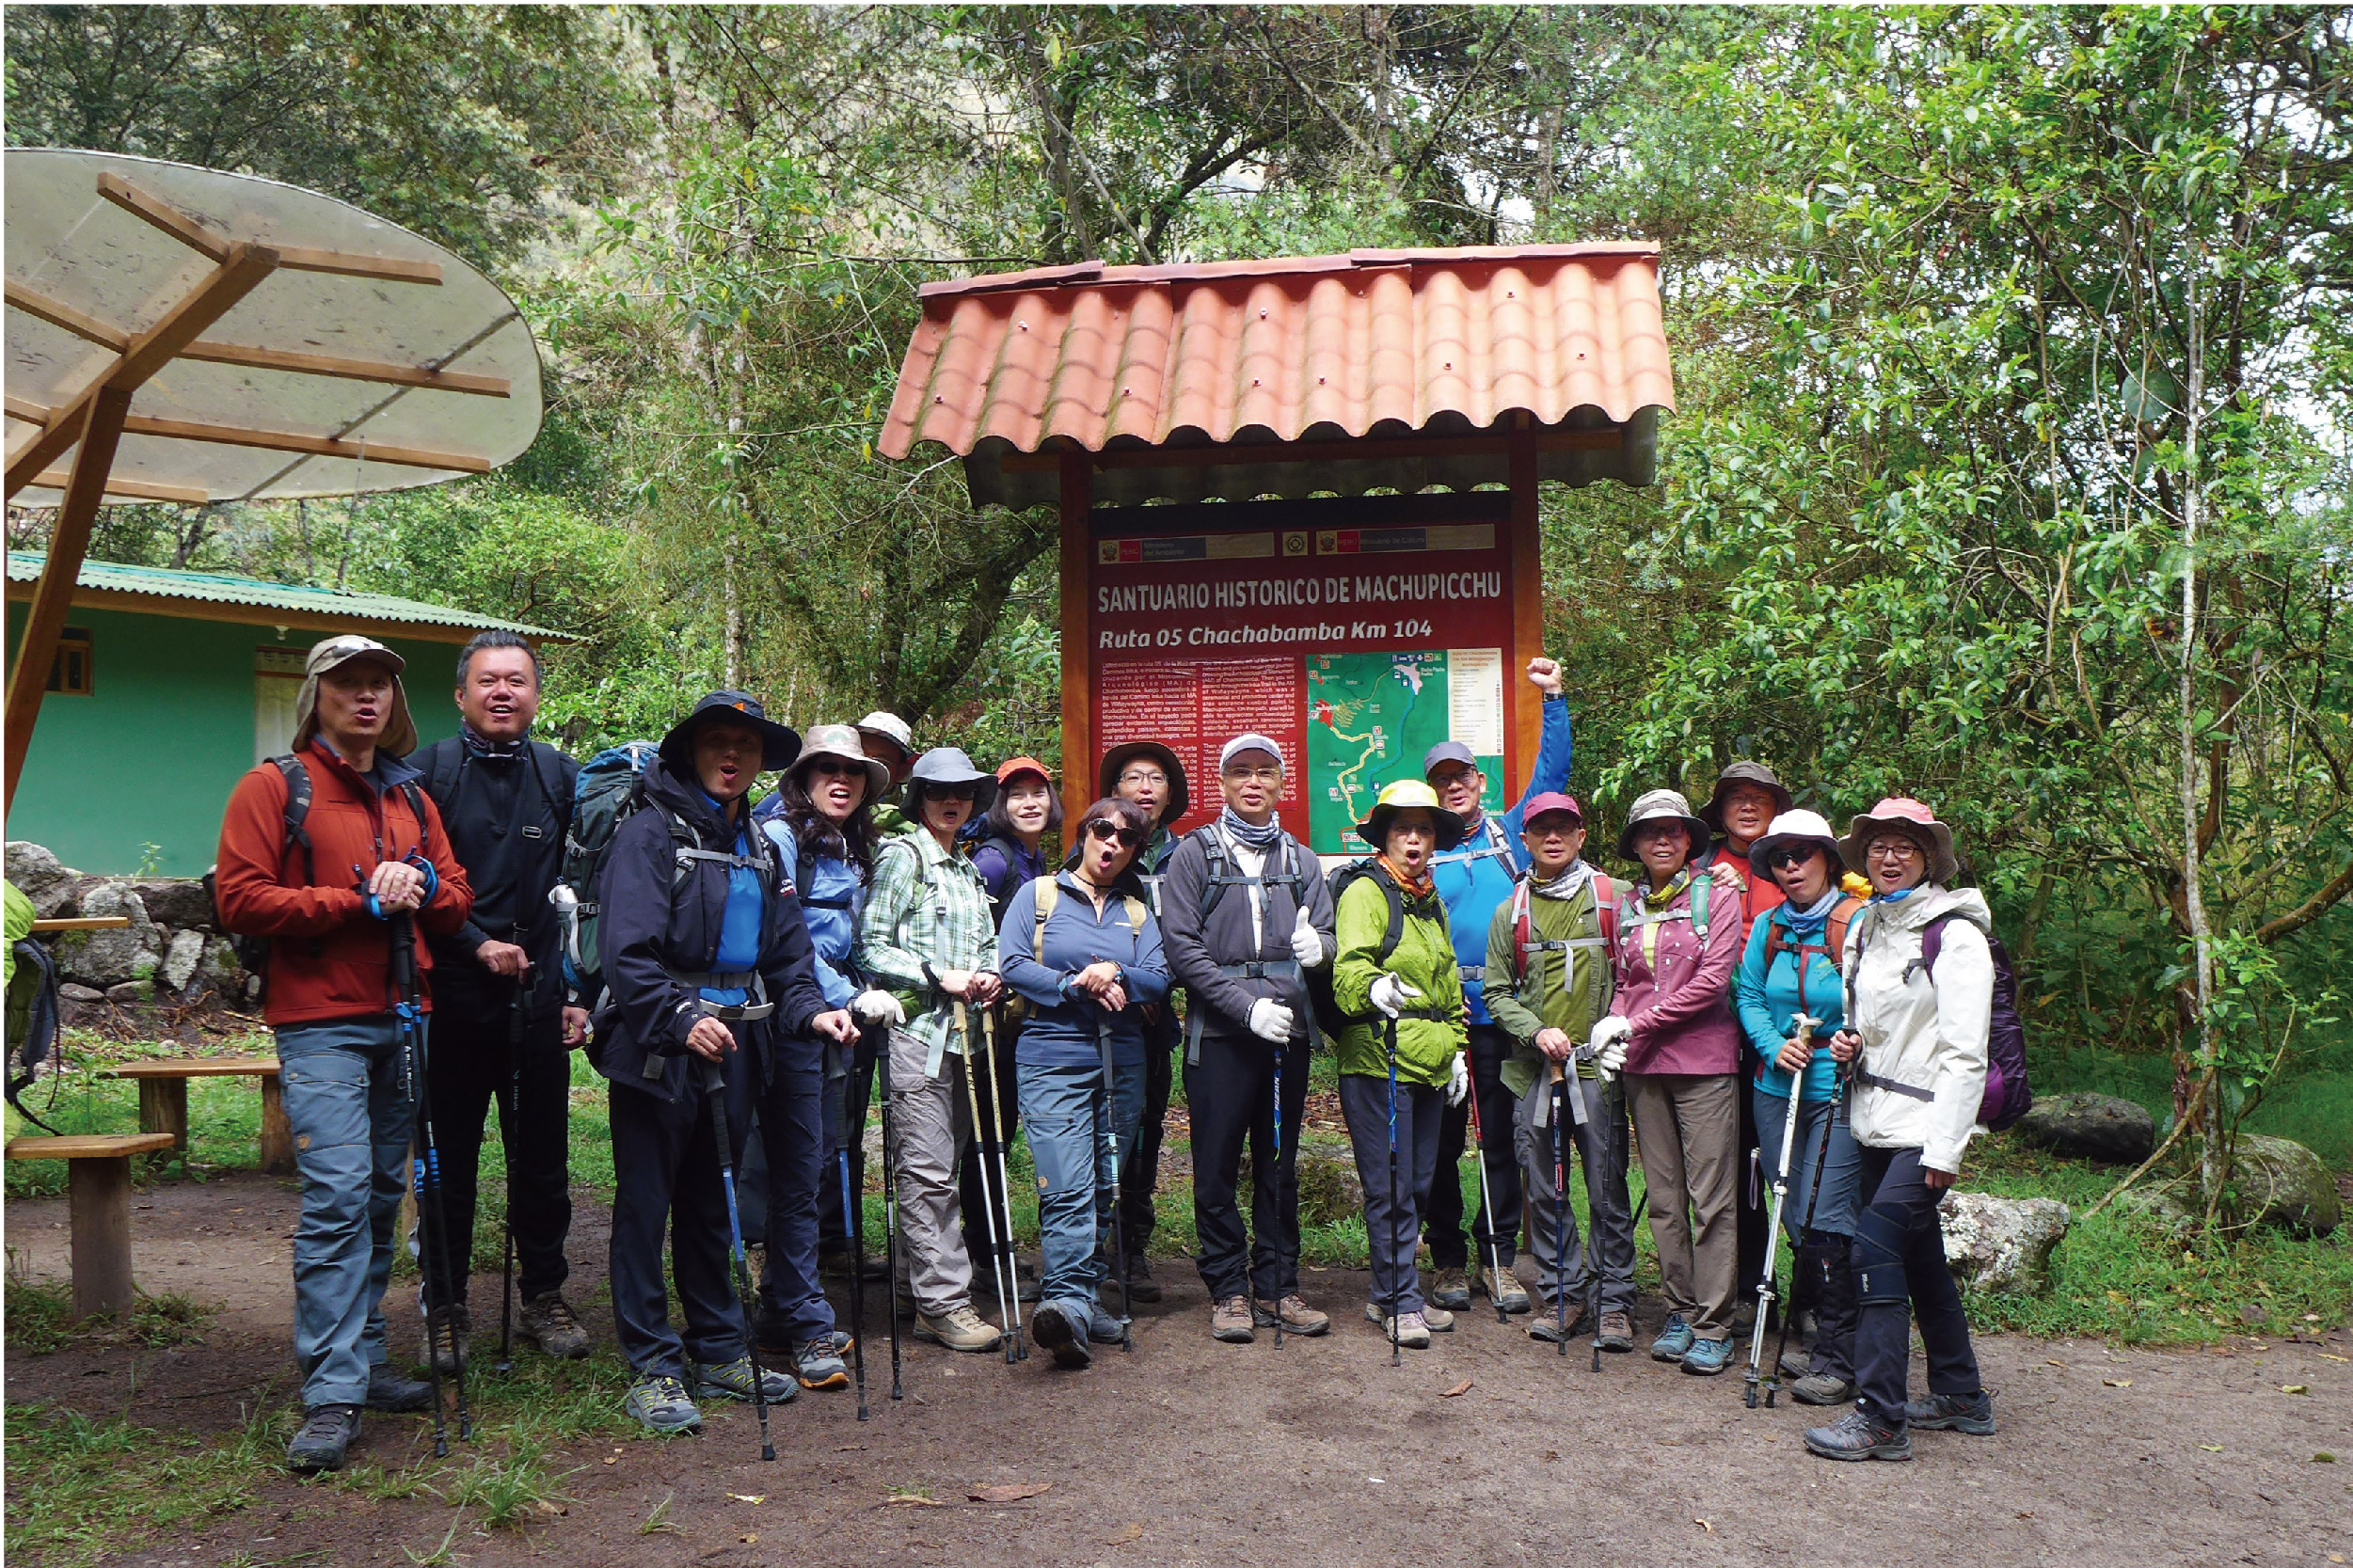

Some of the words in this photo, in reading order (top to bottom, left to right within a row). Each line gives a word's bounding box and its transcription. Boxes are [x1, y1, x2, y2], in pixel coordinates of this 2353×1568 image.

[1098, 582, 1210, 612] SANTUARIO
[1215, 578, 1320, 609] HISTORICO
[1325, 577, 1350, 604] DE
[1355, 571, 1501, 603] MACHUPICCHU
[1099, 629, 1151, 649] Ruta
[1155, 627, 1183, 647] 05
[1188, 622, 1345, 645] Chachabamba
[1350, 621, 1387, 640] Km
[1393, 618, 1433, 638] 104
